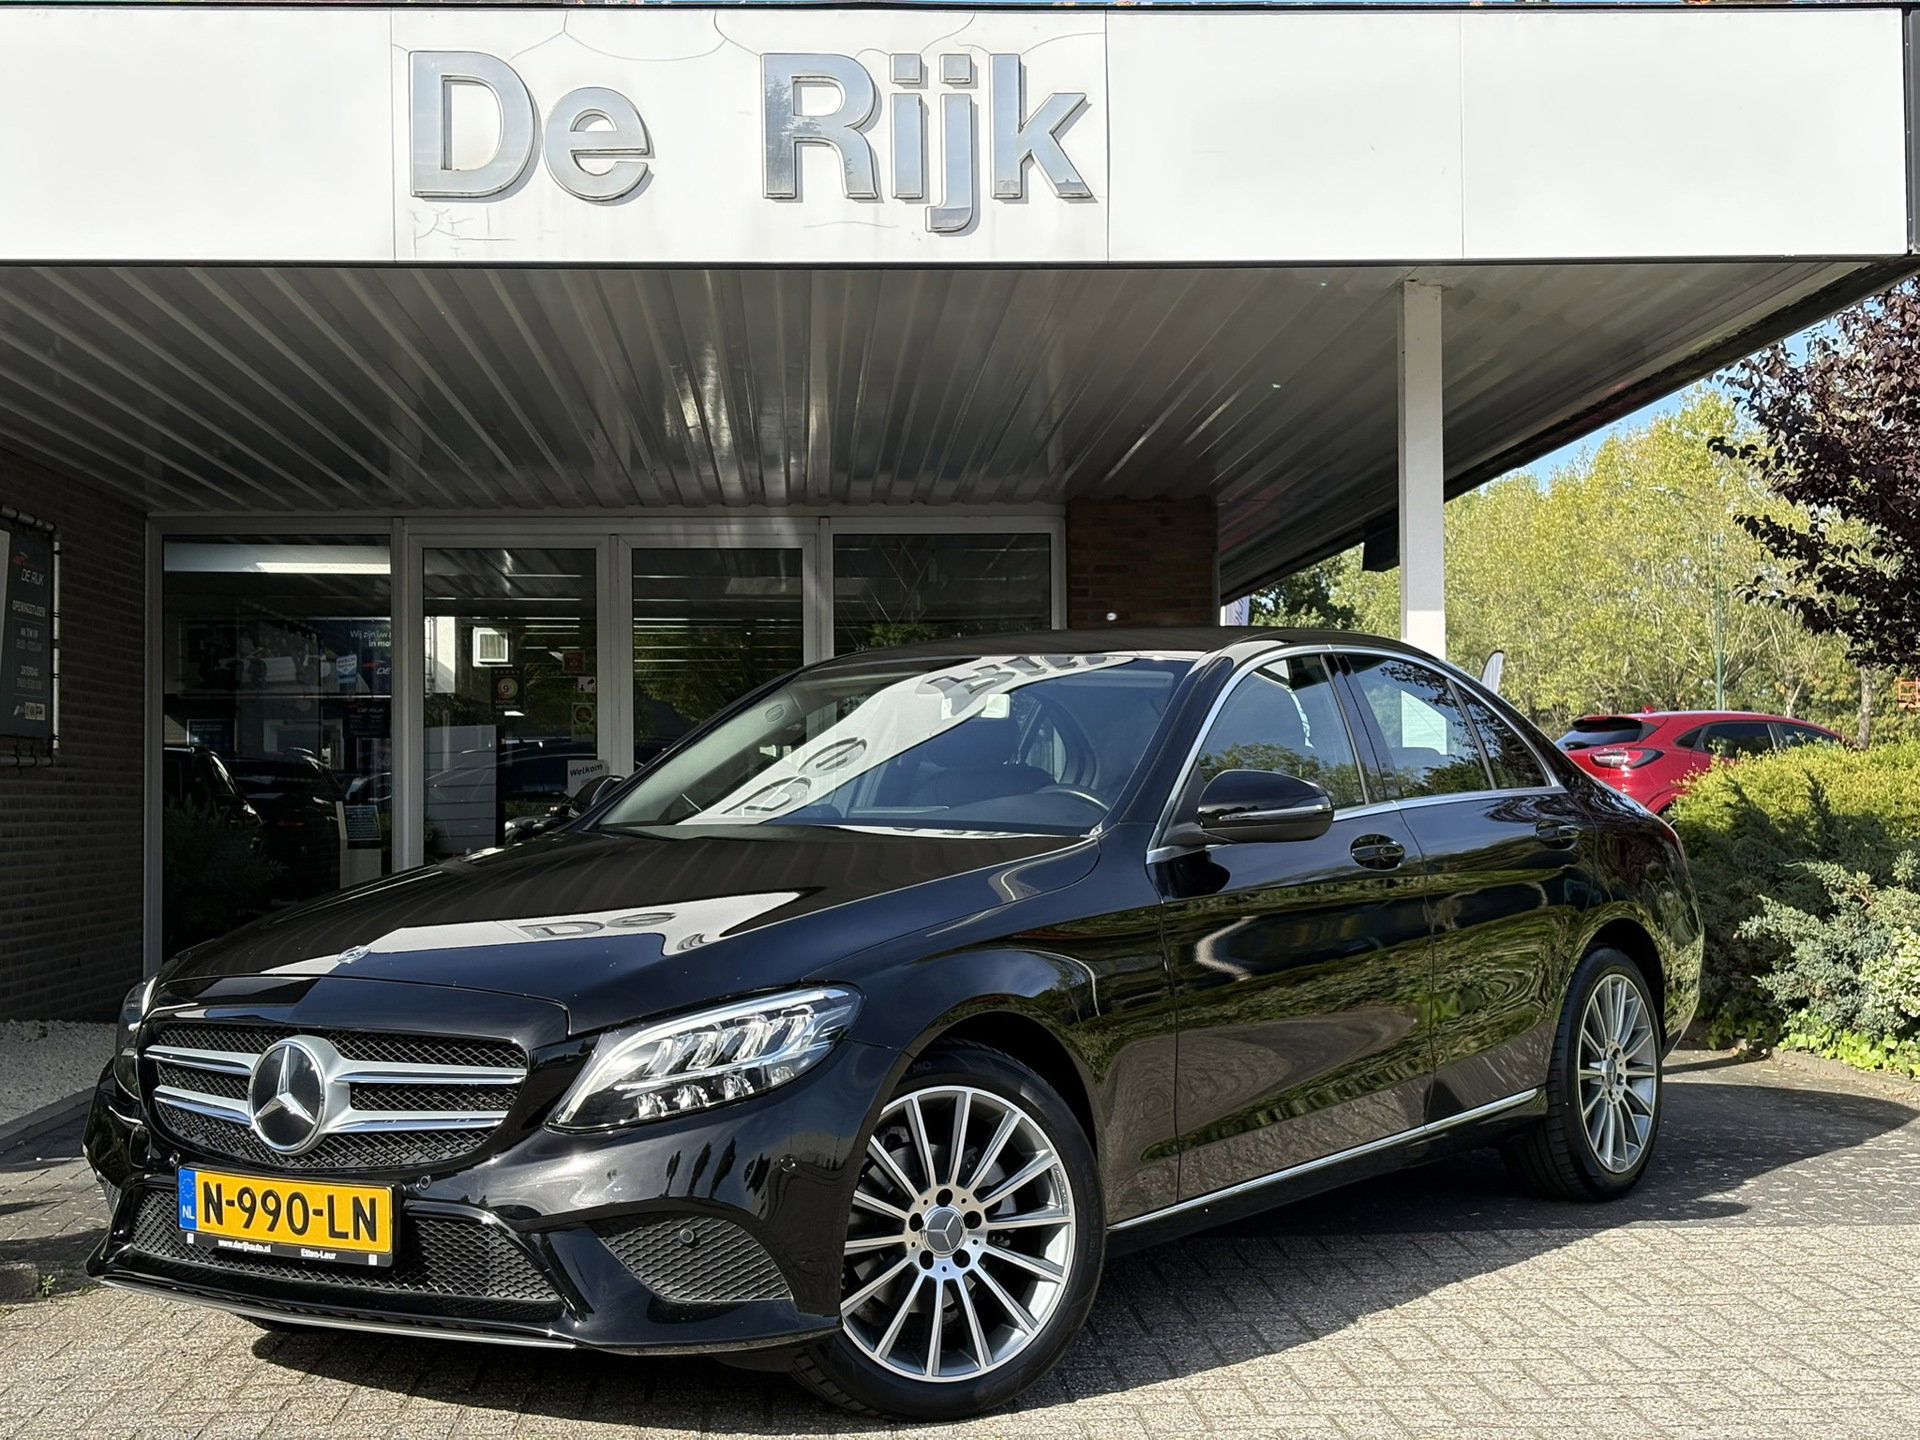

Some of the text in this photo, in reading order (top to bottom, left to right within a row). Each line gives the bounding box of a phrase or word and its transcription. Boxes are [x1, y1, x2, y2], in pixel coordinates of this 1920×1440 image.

[409, 51, 1094, 233] De Rijk
[21, 568, 31, 583] DE
[350, 630, 362, 640] Wij
[569, 763, 603, 777] Welkom
[182, 1204, 195, 1220] NL
[203, 1181, 377, 1243] N-990-LN
[300, 1248, 336, 1260] Etten-Leur
